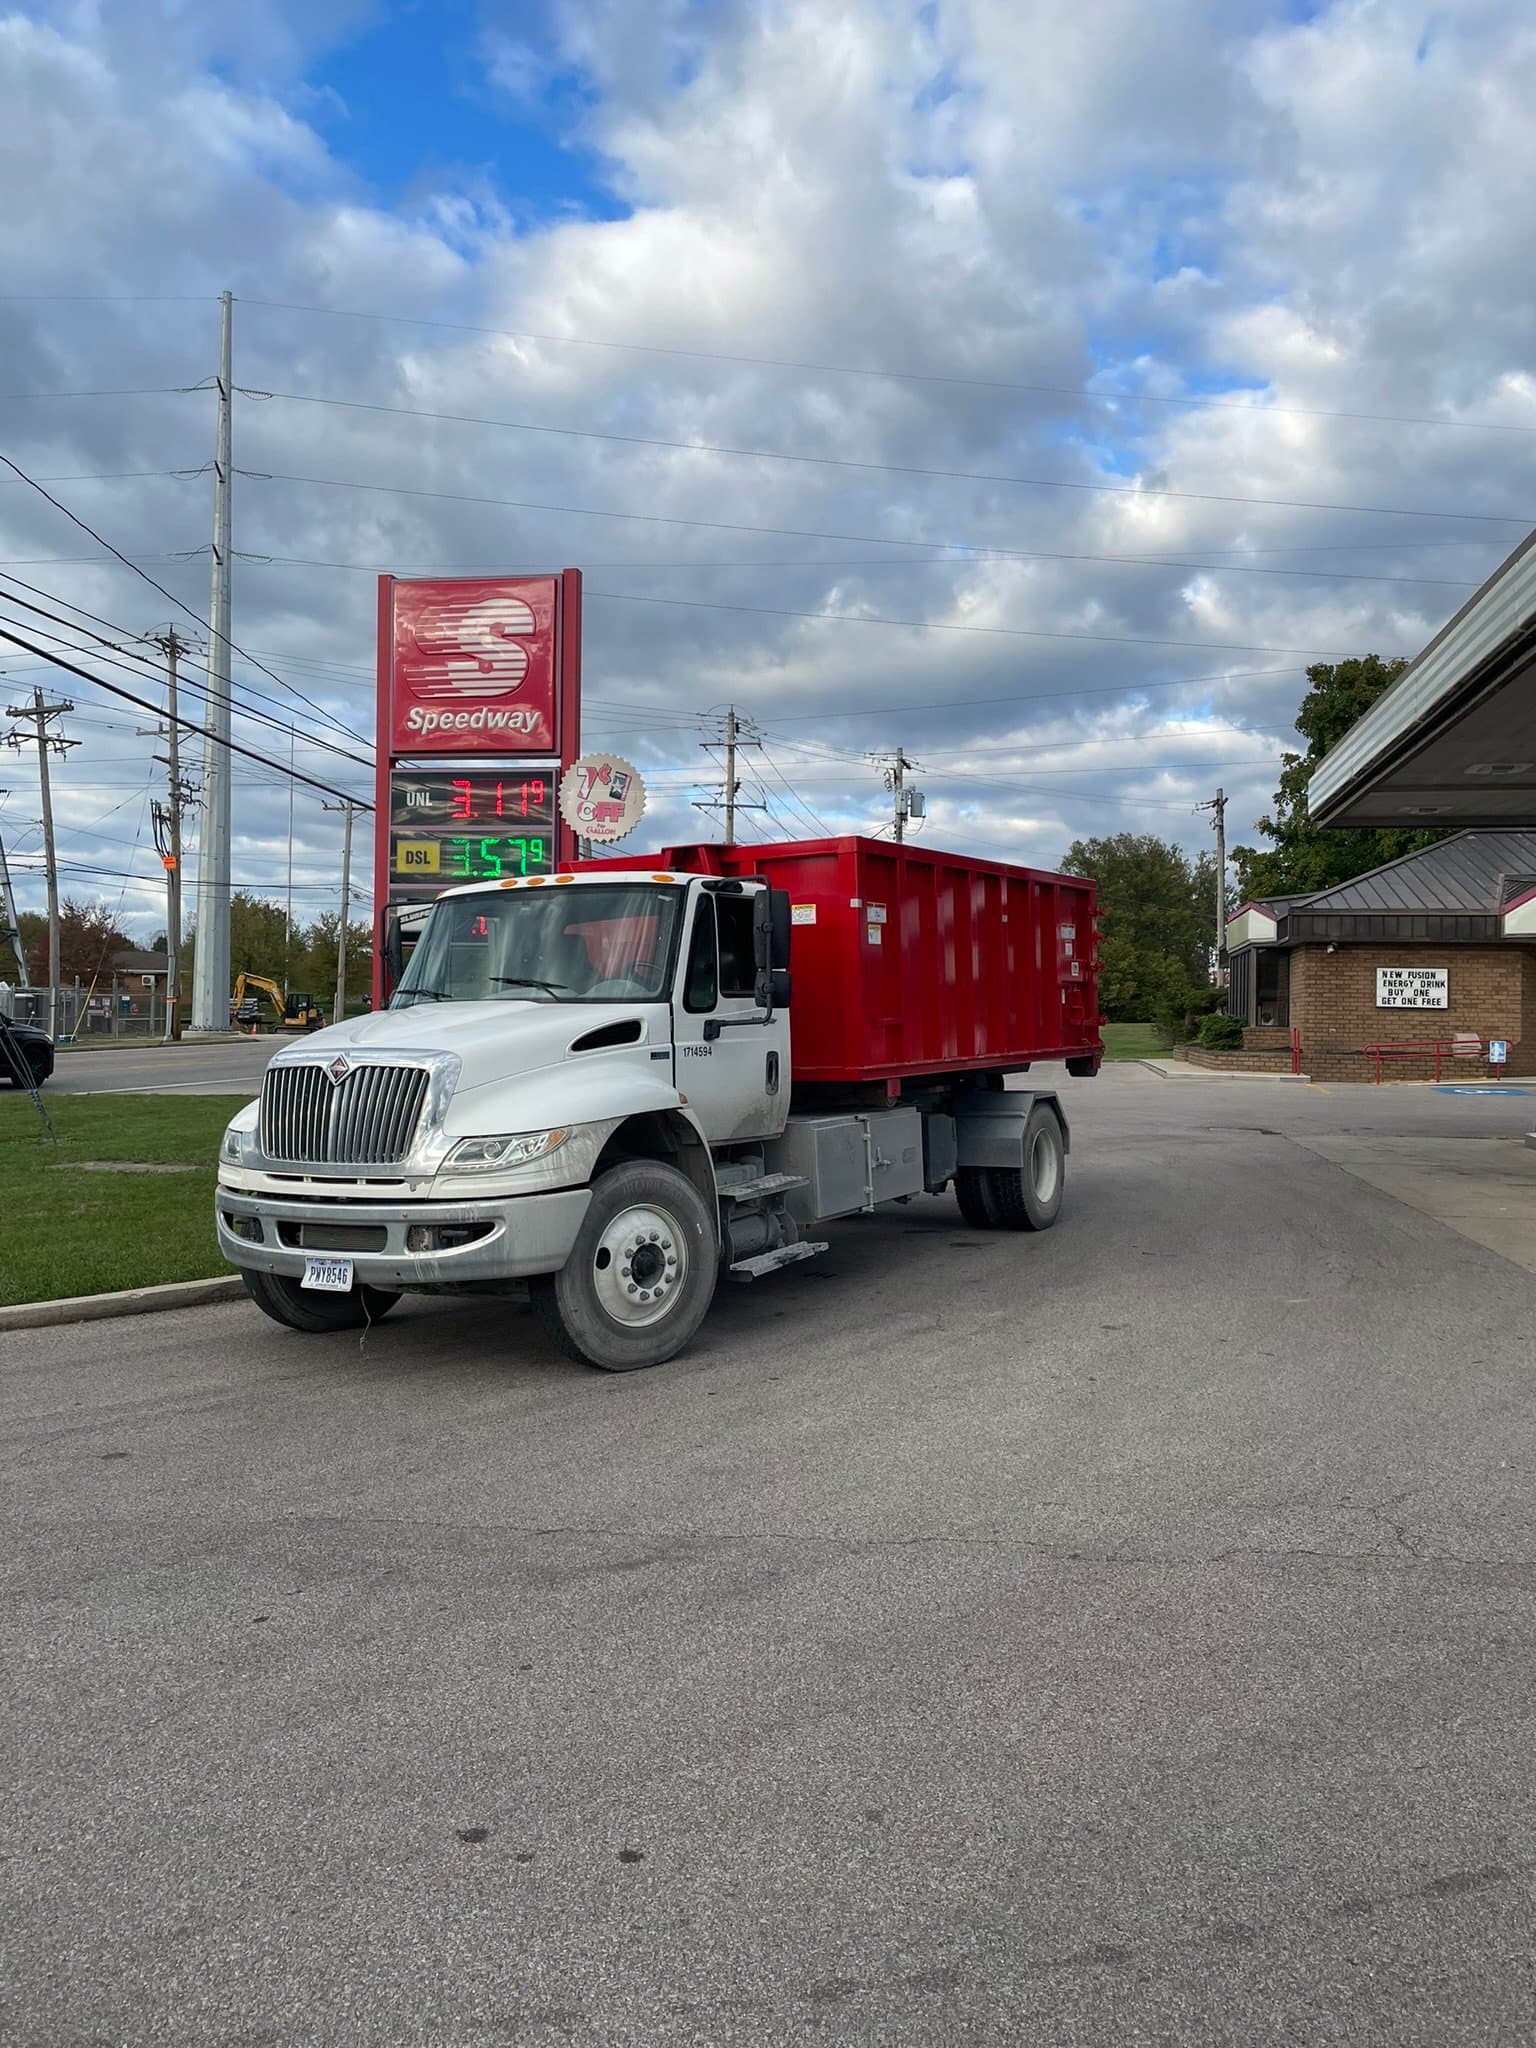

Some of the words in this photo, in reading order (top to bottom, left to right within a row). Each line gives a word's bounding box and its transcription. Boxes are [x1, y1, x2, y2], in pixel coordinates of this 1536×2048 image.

[407, 706, 542, 735] Speedway
[406, 791, 433, 807] UNL
[577, 801, 625, 822] OFF
[405, 850, 431, 864] DSL
[1382, 970, 1403, 979] NEW
[1407, 971, 1436, 979] FUSION
[1383, 979, 1414, 988] ENERGY
[1420, 980, 1446, 988] DRINK
[1388, 988, 1404, 996] BUY
[1414, 989, 1430, 997] ONE
[1381, 997, 1397, 1005] GET
[1402, 997, 1418, 1005] ONE
[1422, 998, 1441, 1006] FREE
[683, 1046, 713, 1057] 1714594
